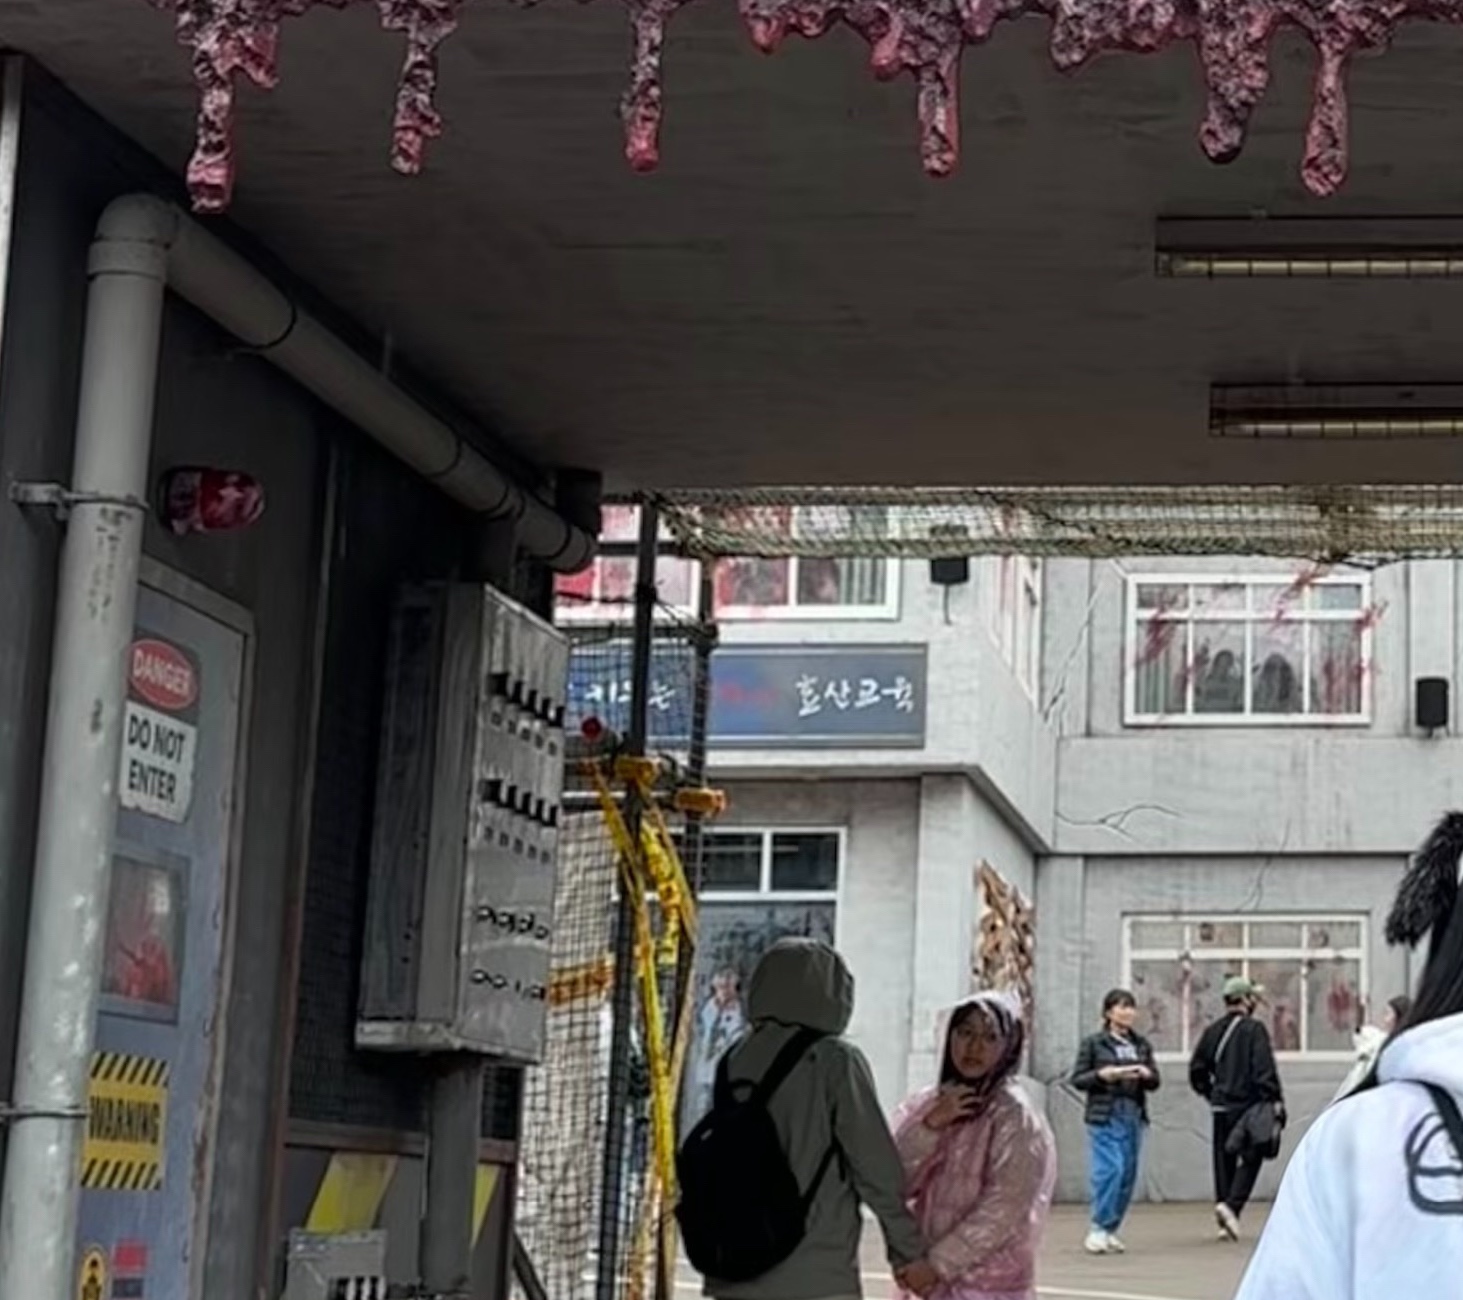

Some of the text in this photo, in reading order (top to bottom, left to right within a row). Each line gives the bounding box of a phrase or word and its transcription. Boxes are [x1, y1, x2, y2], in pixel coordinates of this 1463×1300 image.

[133, 648, 191, 696] DANGER
[127, 713, 186, 763] DO NOT
[127, 758, 177, 802] ENTER
[89, 1095, 160, 1145] WARNING
